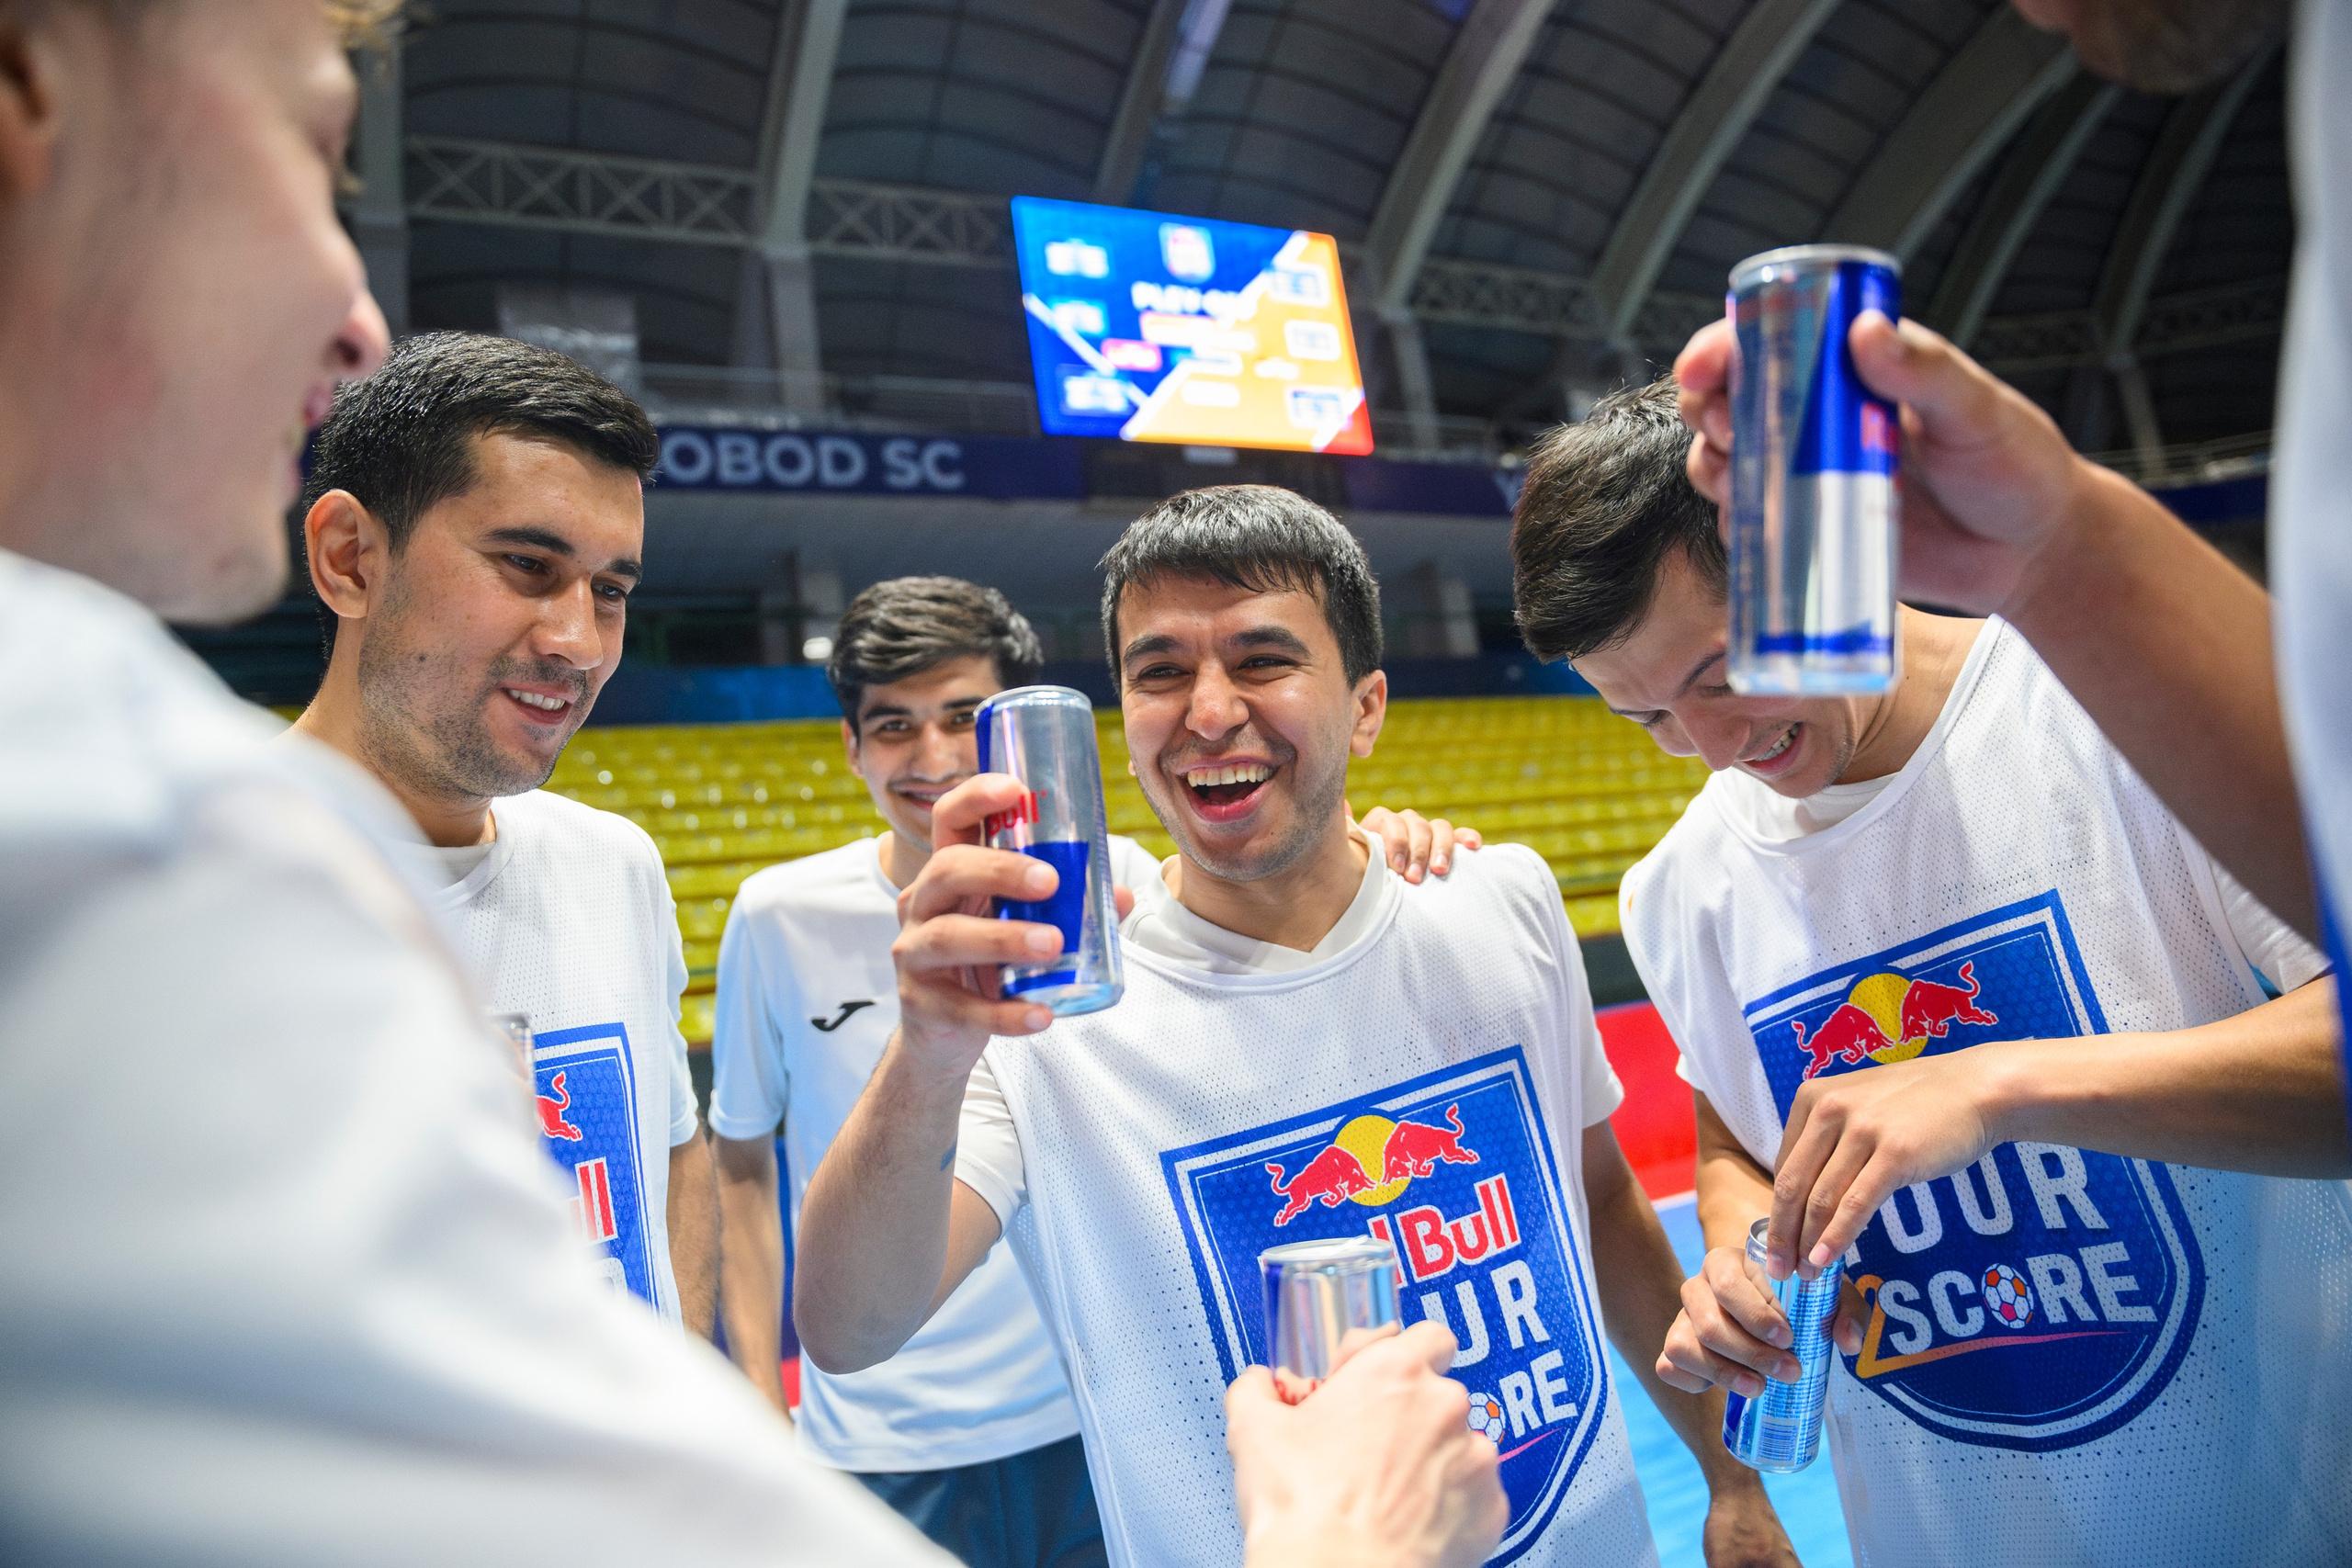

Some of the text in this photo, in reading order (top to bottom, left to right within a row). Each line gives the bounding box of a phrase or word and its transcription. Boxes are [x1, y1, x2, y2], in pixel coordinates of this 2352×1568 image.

[662, 433, 966, 491] OBOD SC
[1396, 1173, 1521, 1281] Bull
[1845, 1141, 2109, 1267] OUR
[1420, 1259, 1550, 1368] UR
